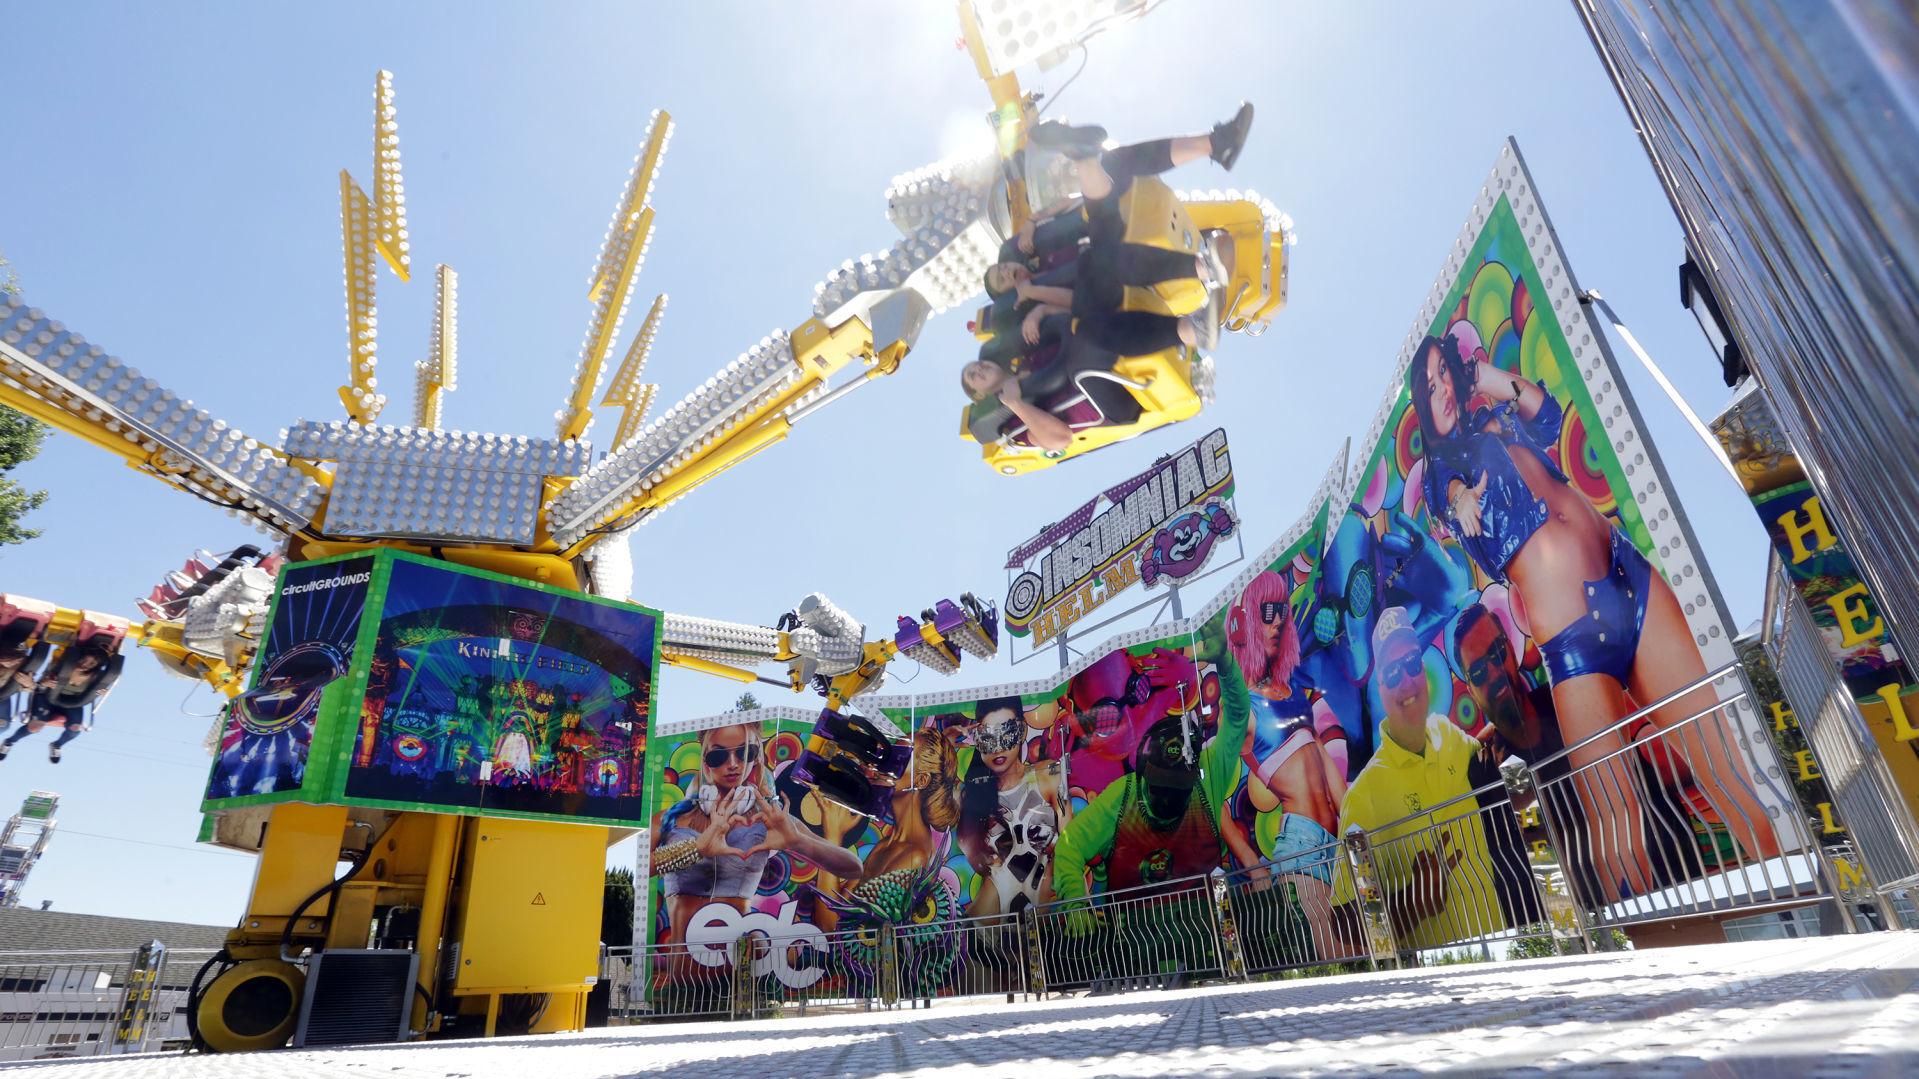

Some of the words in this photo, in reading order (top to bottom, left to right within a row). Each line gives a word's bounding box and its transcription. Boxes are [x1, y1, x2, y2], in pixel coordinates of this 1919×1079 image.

[1041, 427, 1233, 605] INSOMNIAC
[282, 571, 371, 595] circuitGROUNDS
[1029, 552, 1141, 649] HELM
[685, 902, 831, 989] edc
